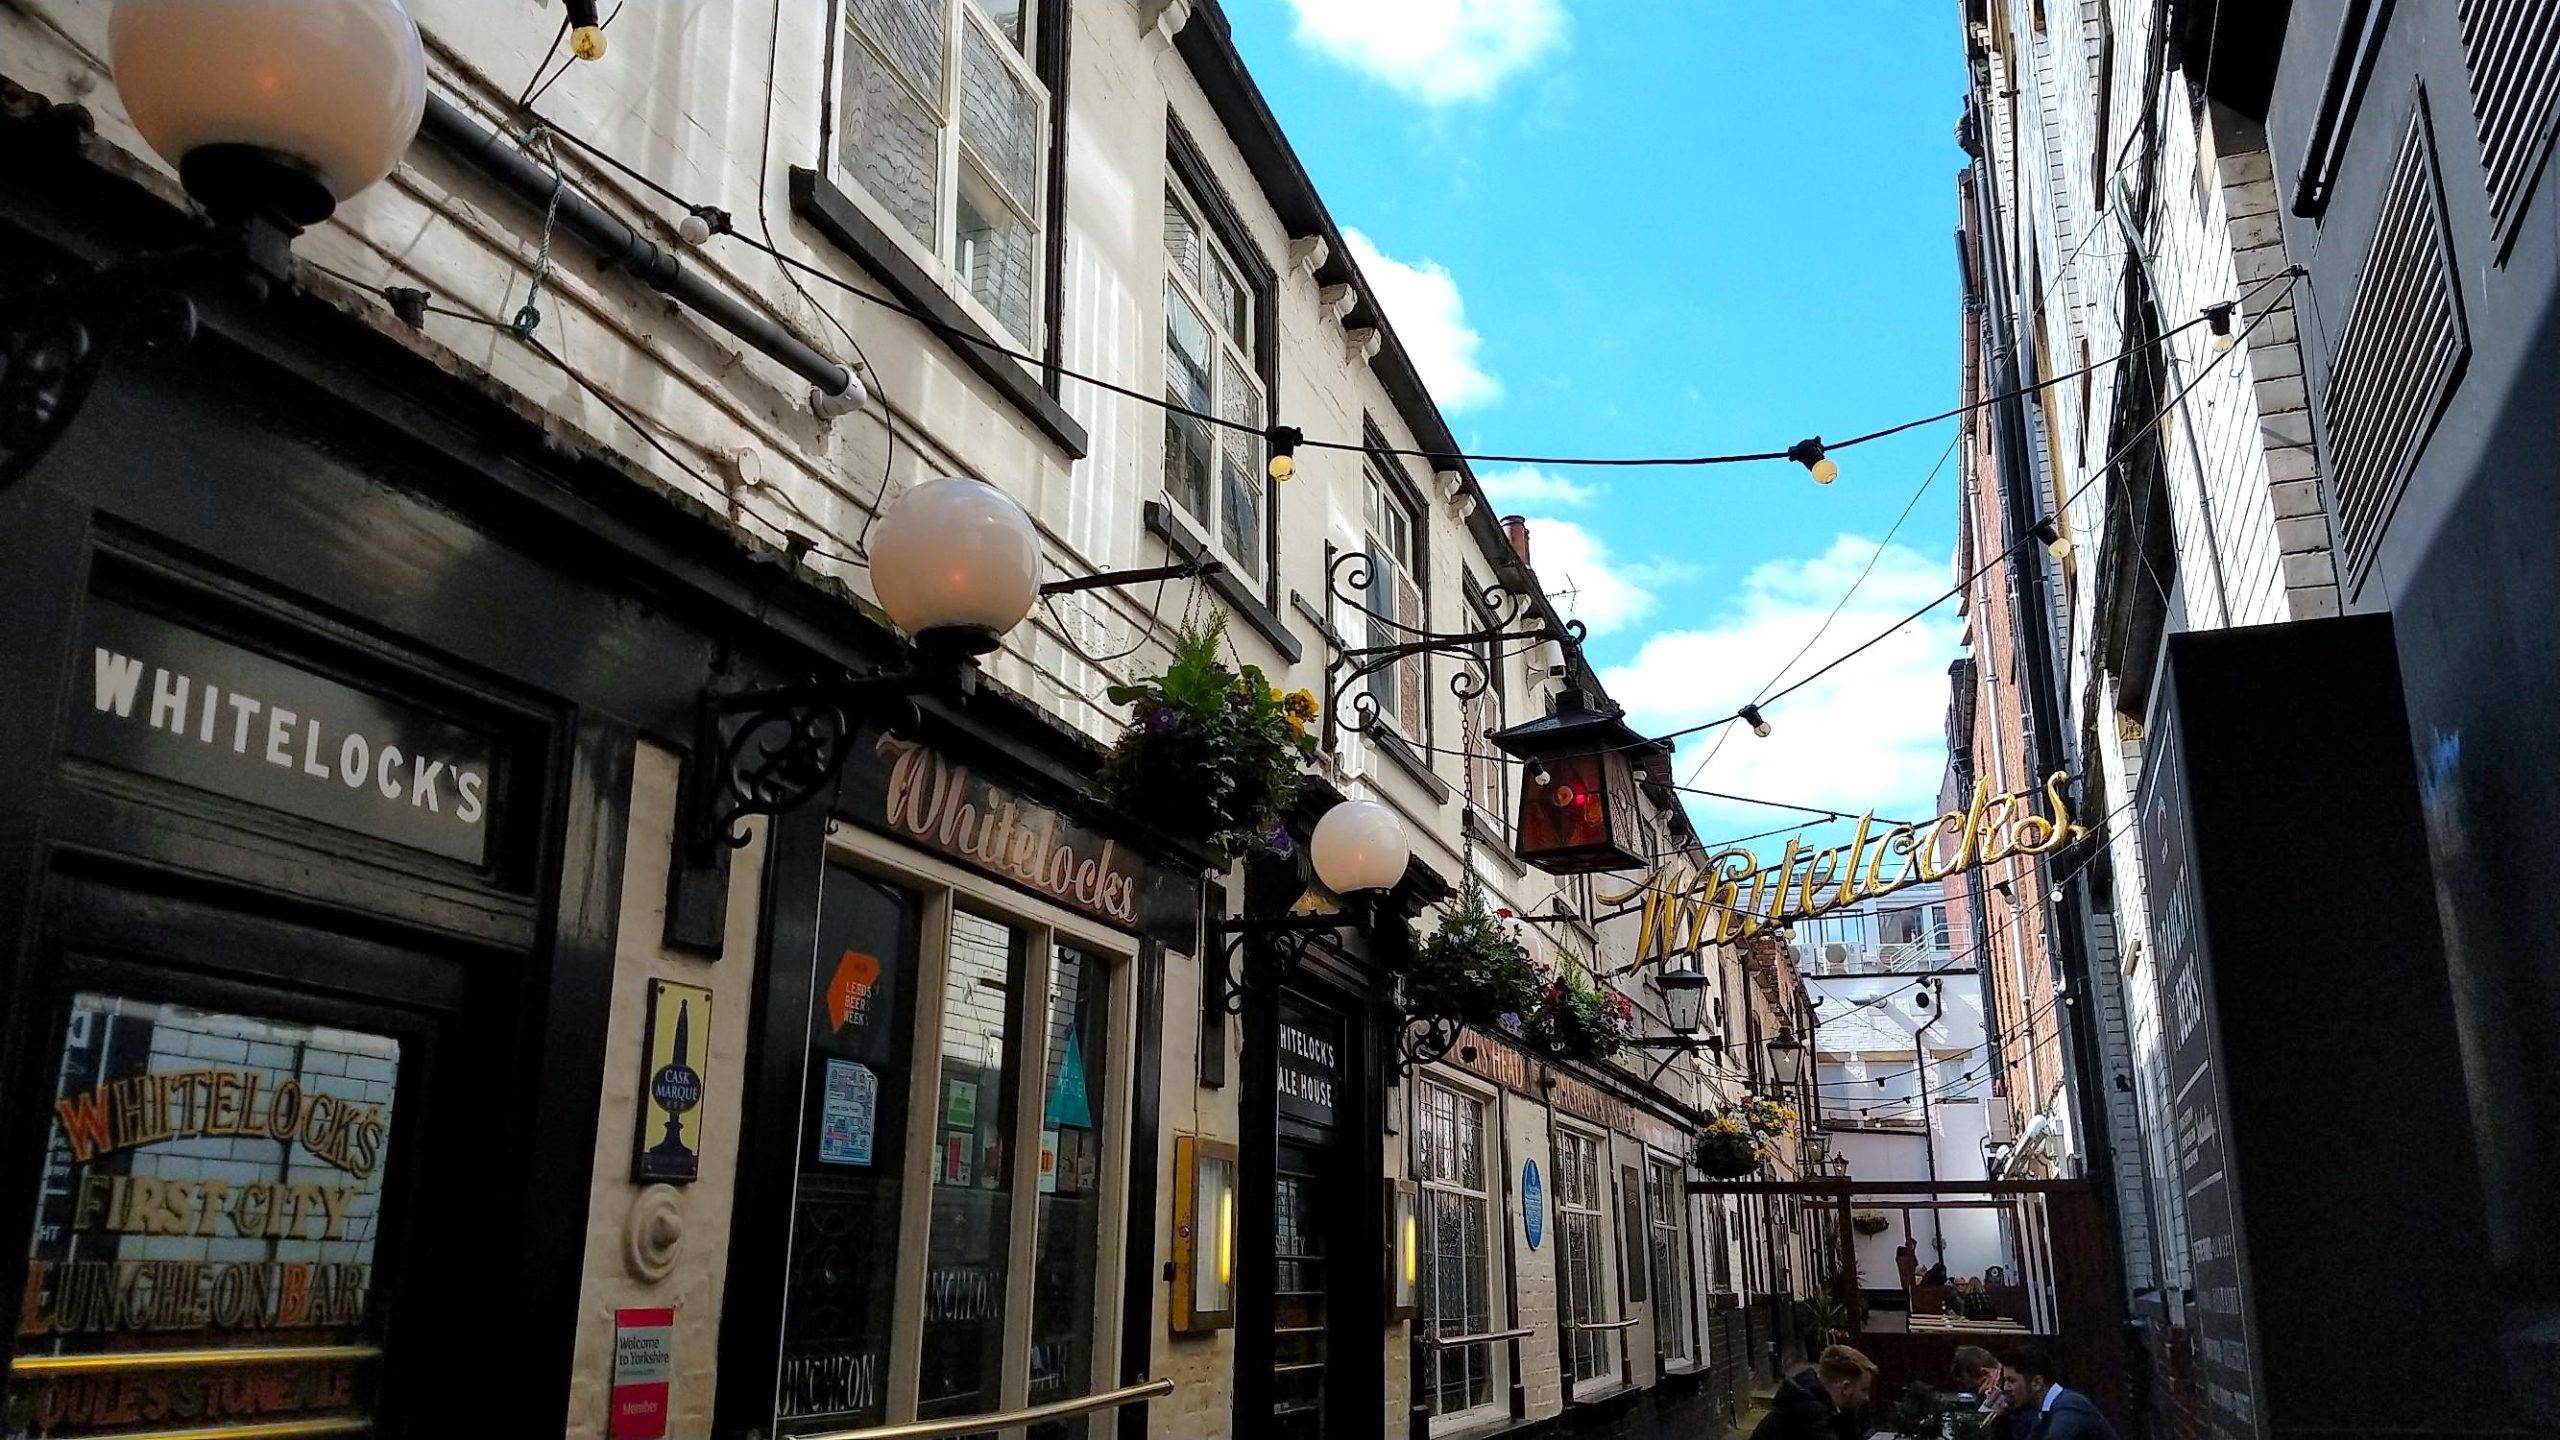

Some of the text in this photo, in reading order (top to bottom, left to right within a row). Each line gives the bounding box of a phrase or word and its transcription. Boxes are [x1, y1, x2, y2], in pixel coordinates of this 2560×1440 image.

[95, 647, 483, 823] WHITELOCK'S
[875, 730, 1138, 922] Whitelocks
[1597, 770, 2087, 975] Whitelocks
[845, 981, 872, 998] LEEDS
[2175, 952, 2201, 1048] BEERS
[665, 1069, 691, 1085] CASK
[1491, 1040, 1524, 1088] HEAD
[656, 1084, 698, 1102] MARQUE
[1278, 1066, 1333, 1108] ALE HOUSE
[72, 1176, 355, 1241] FIRST CITY
[17, 1258, 366, 1336] LUNCHEON BAR
[619, 1336, 660, 1350] Welcome
[619, 1351, 670, 1366] to Yorkshire
[622, 1400, 658, 1416] Member
